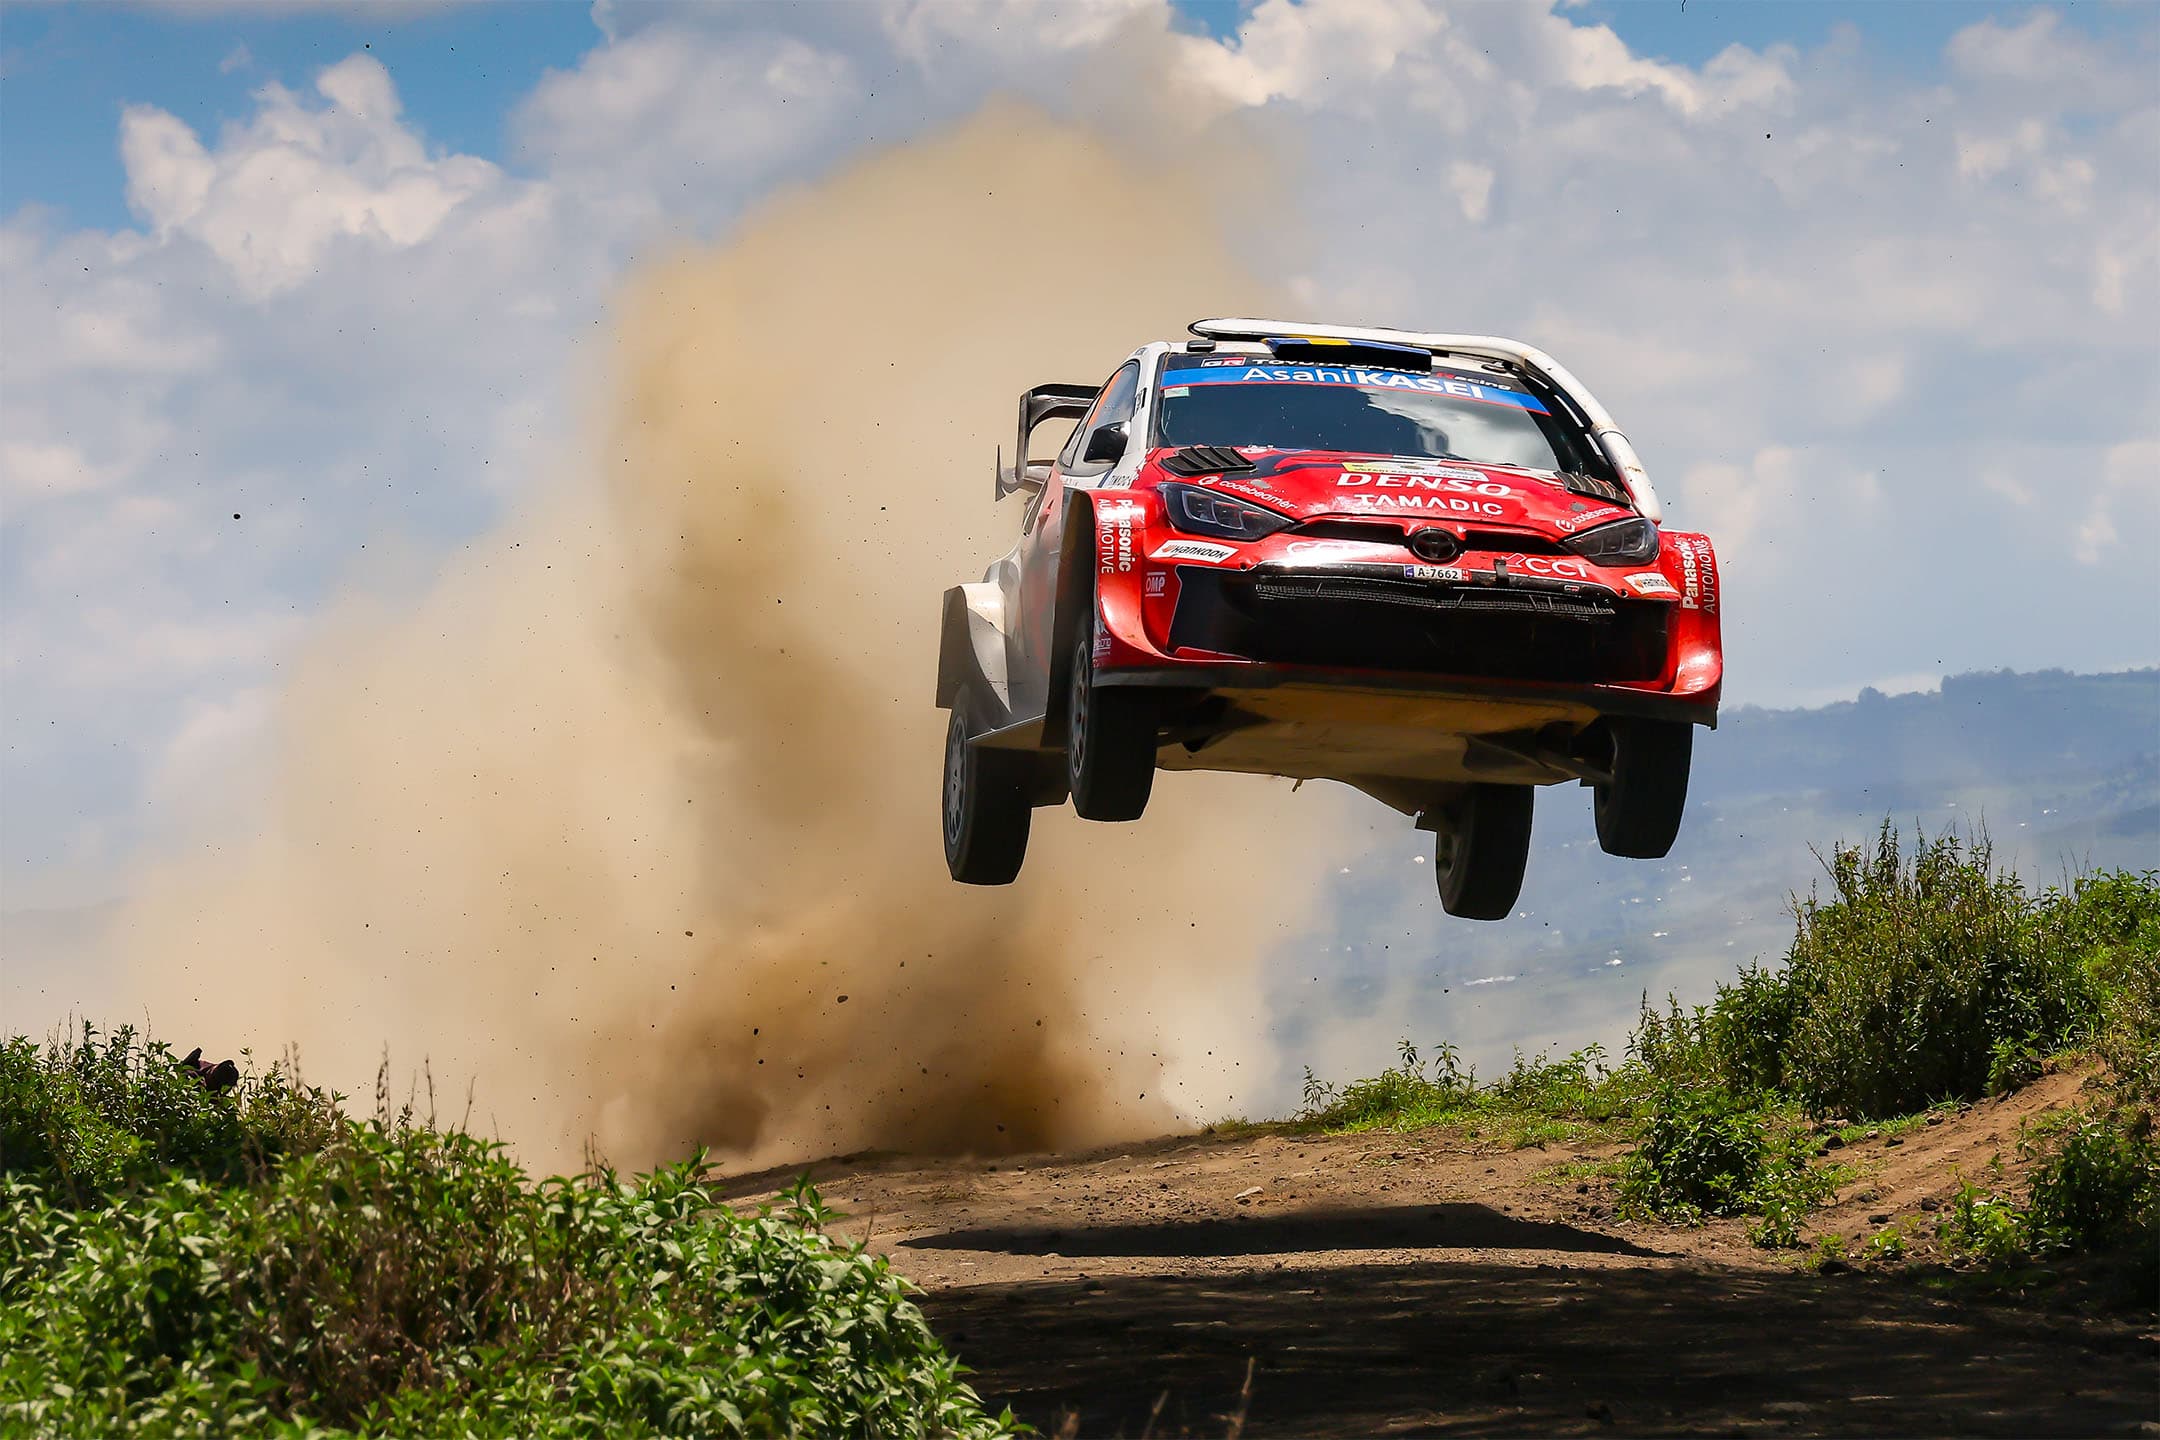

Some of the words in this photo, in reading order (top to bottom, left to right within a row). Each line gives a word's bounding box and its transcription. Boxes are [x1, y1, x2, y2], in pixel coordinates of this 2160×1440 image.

[1243, 368, 1352, 383] Asahi
[1353, 370, 1484, 399] KASEI
[1219, 480, 1297, 509] codebeamer
[1337, 473, 1511, 497] DENSO
[1354, 494, 1503, 515] TAMADIC
[1098, 498, 1114, 574] AUOMOTIVE
[1145, 577, 1166, 592] OMP
[1417, 567, 1459, 580] A-7662
